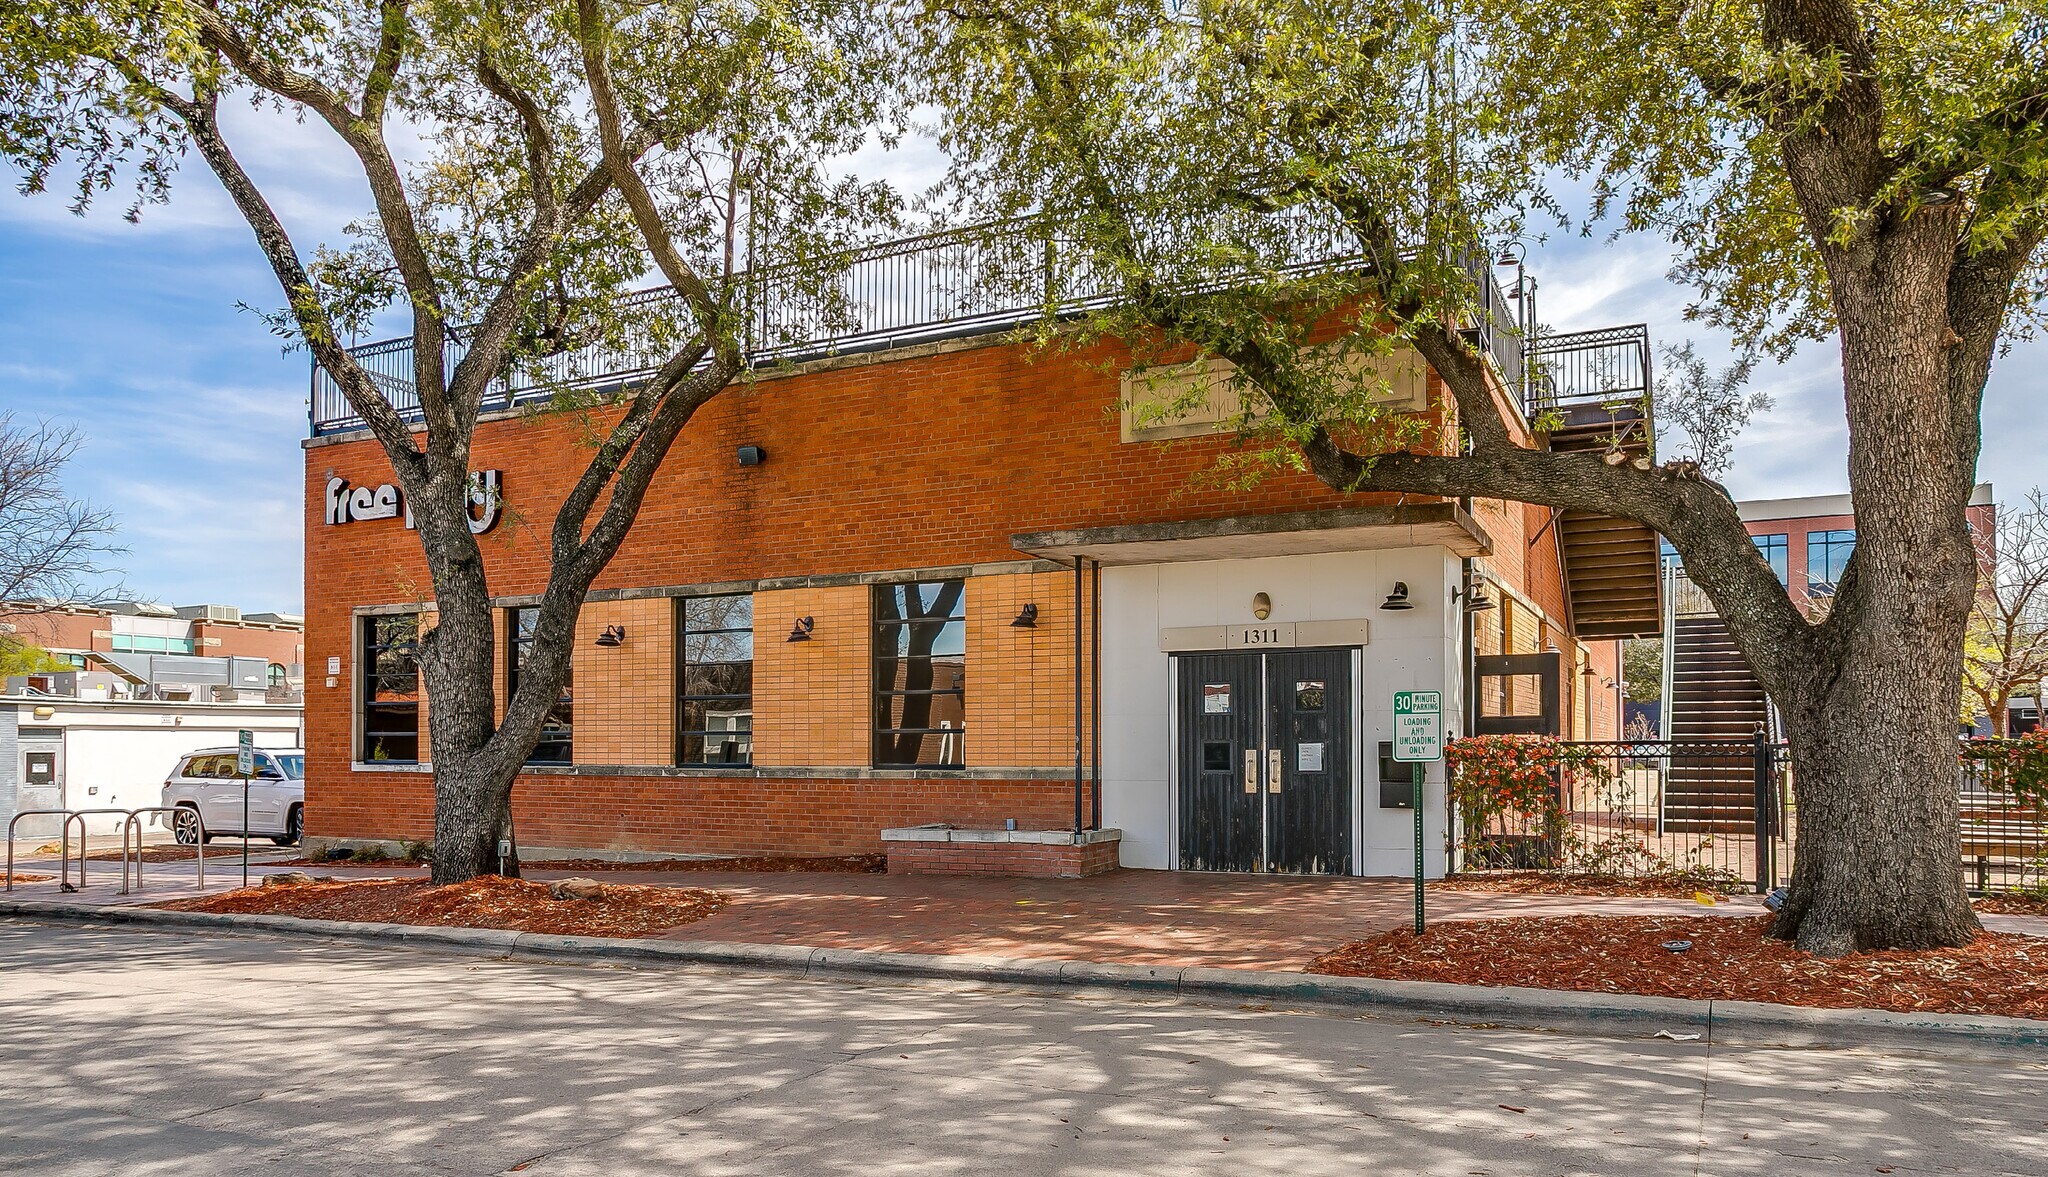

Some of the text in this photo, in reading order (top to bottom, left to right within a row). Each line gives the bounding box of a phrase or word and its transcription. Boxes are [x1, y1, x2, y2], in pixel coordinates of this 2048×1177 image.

[326, 477, 398, 525] free
[1243, 629, 1279, 643] 1311
[1395, 695, 1411, 710] 30
[1414, 694, 1436, 703] MINUTE
[1413, 703, 1438, 711] PARKING
[1403, 717, 1431, 726] LOADING
[1410, 727, 1425, 736] AND
[1399, 736, 1436, 745] UNLOADING
[1408, 746, 1426, 754] ONLY
